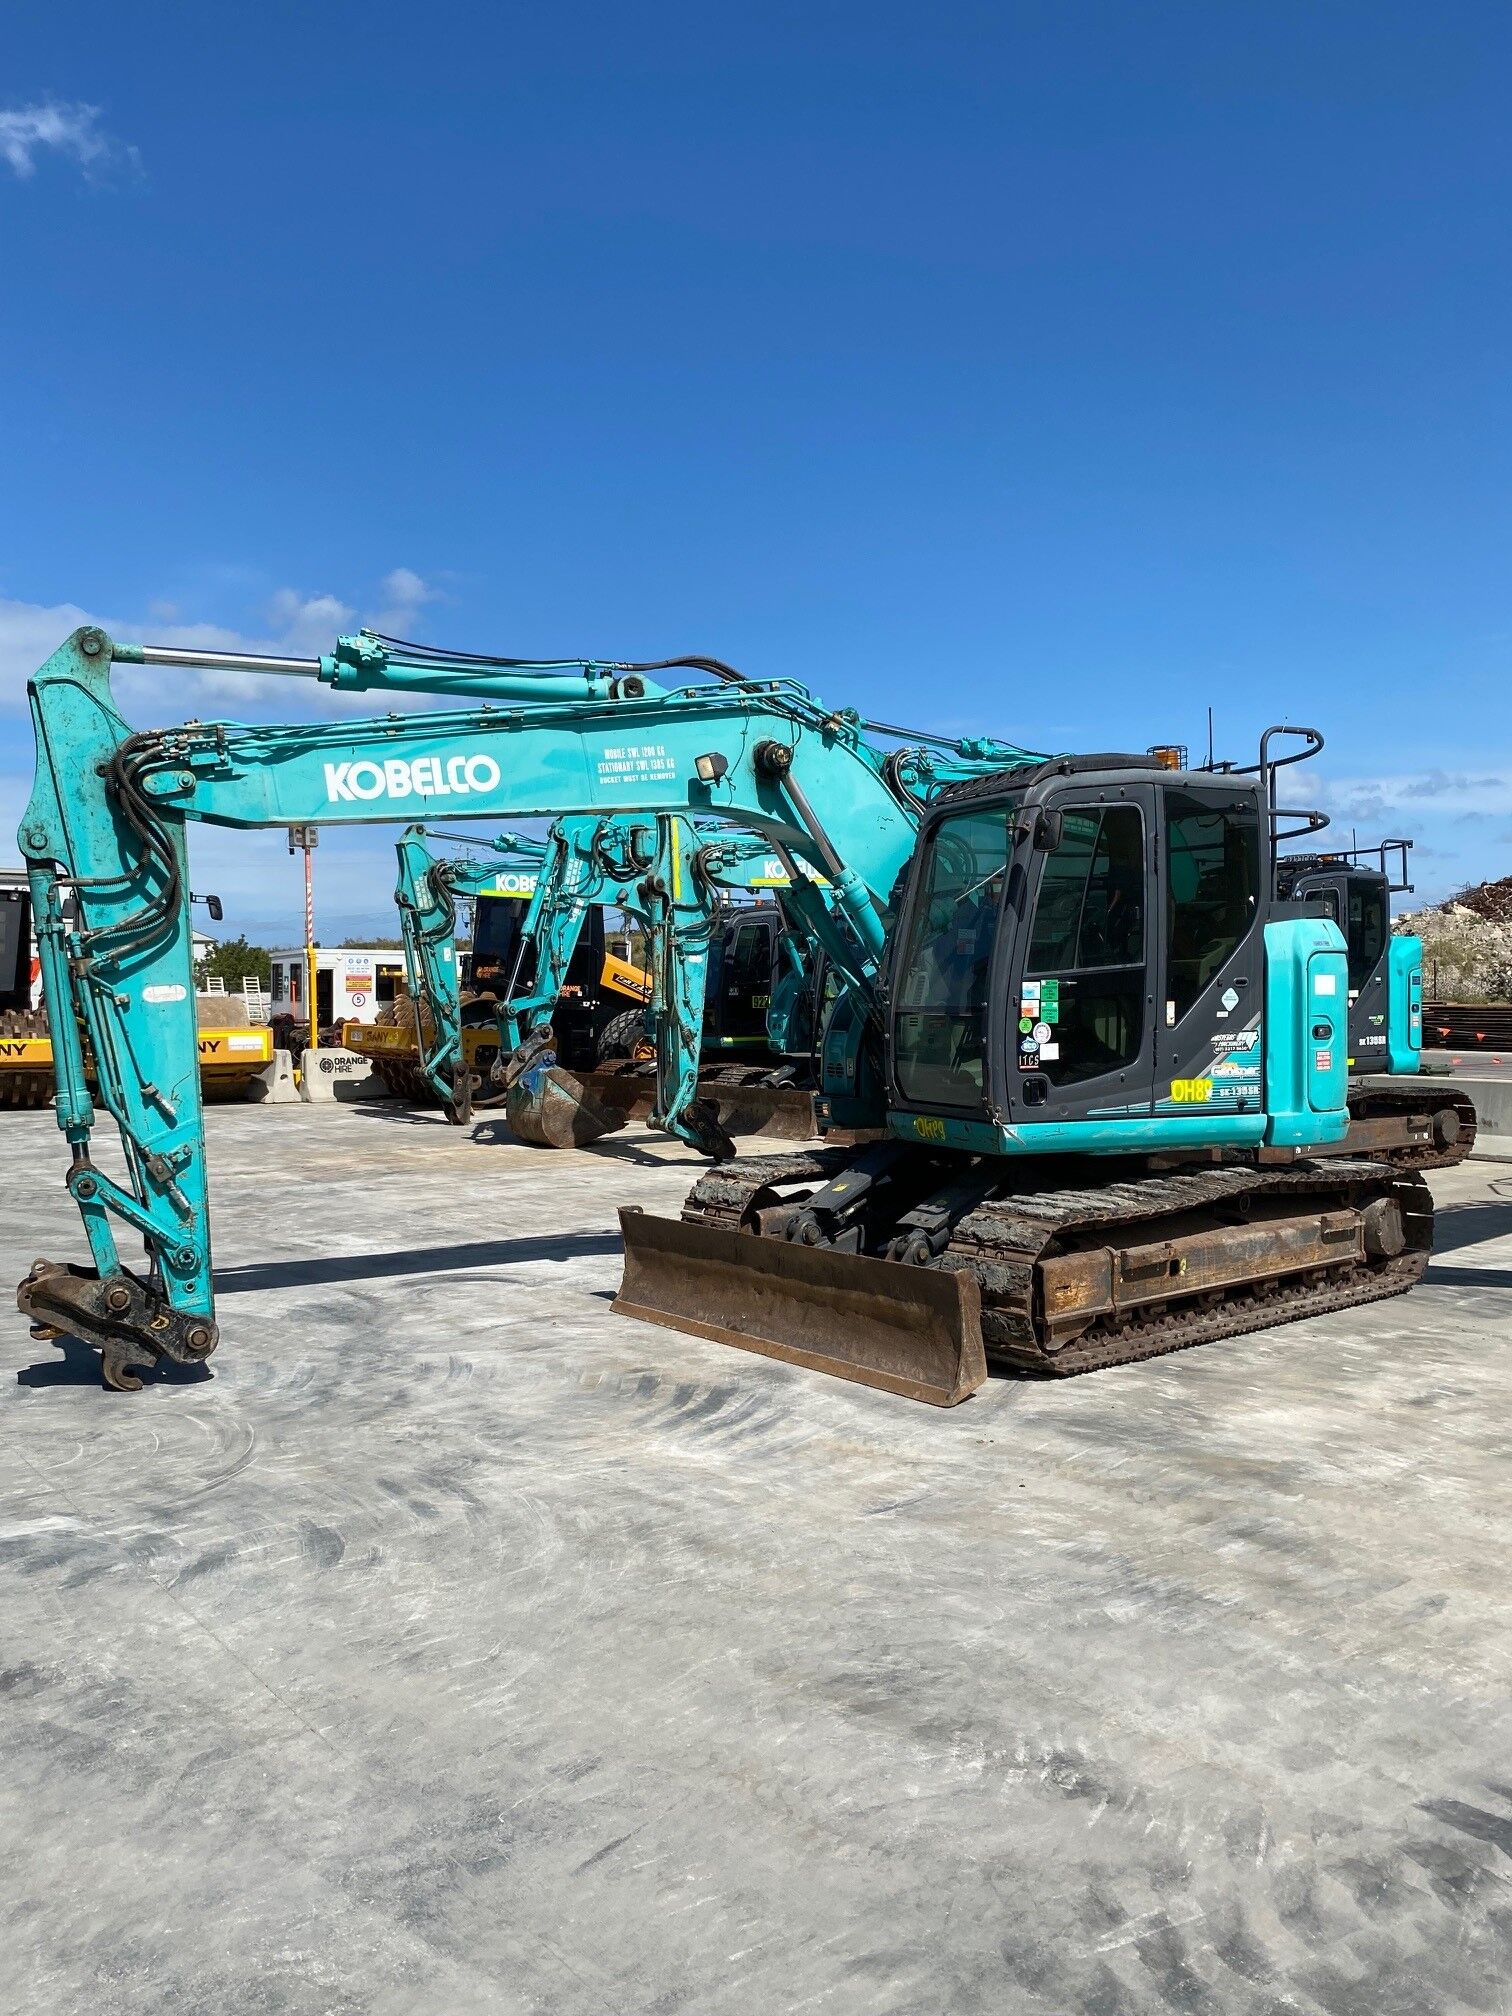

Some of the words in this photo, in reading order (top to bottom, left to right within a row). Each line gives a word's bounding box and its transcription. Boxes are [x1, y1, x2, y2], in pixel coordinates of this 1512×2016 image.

[323, 754, 501, 802] KOBELCO
[334, 1056, 368, 1065] ORANGE
[1019, 1054, 1039, 1066] ITCS
[334, 1065, 353, 1074] HIRE
